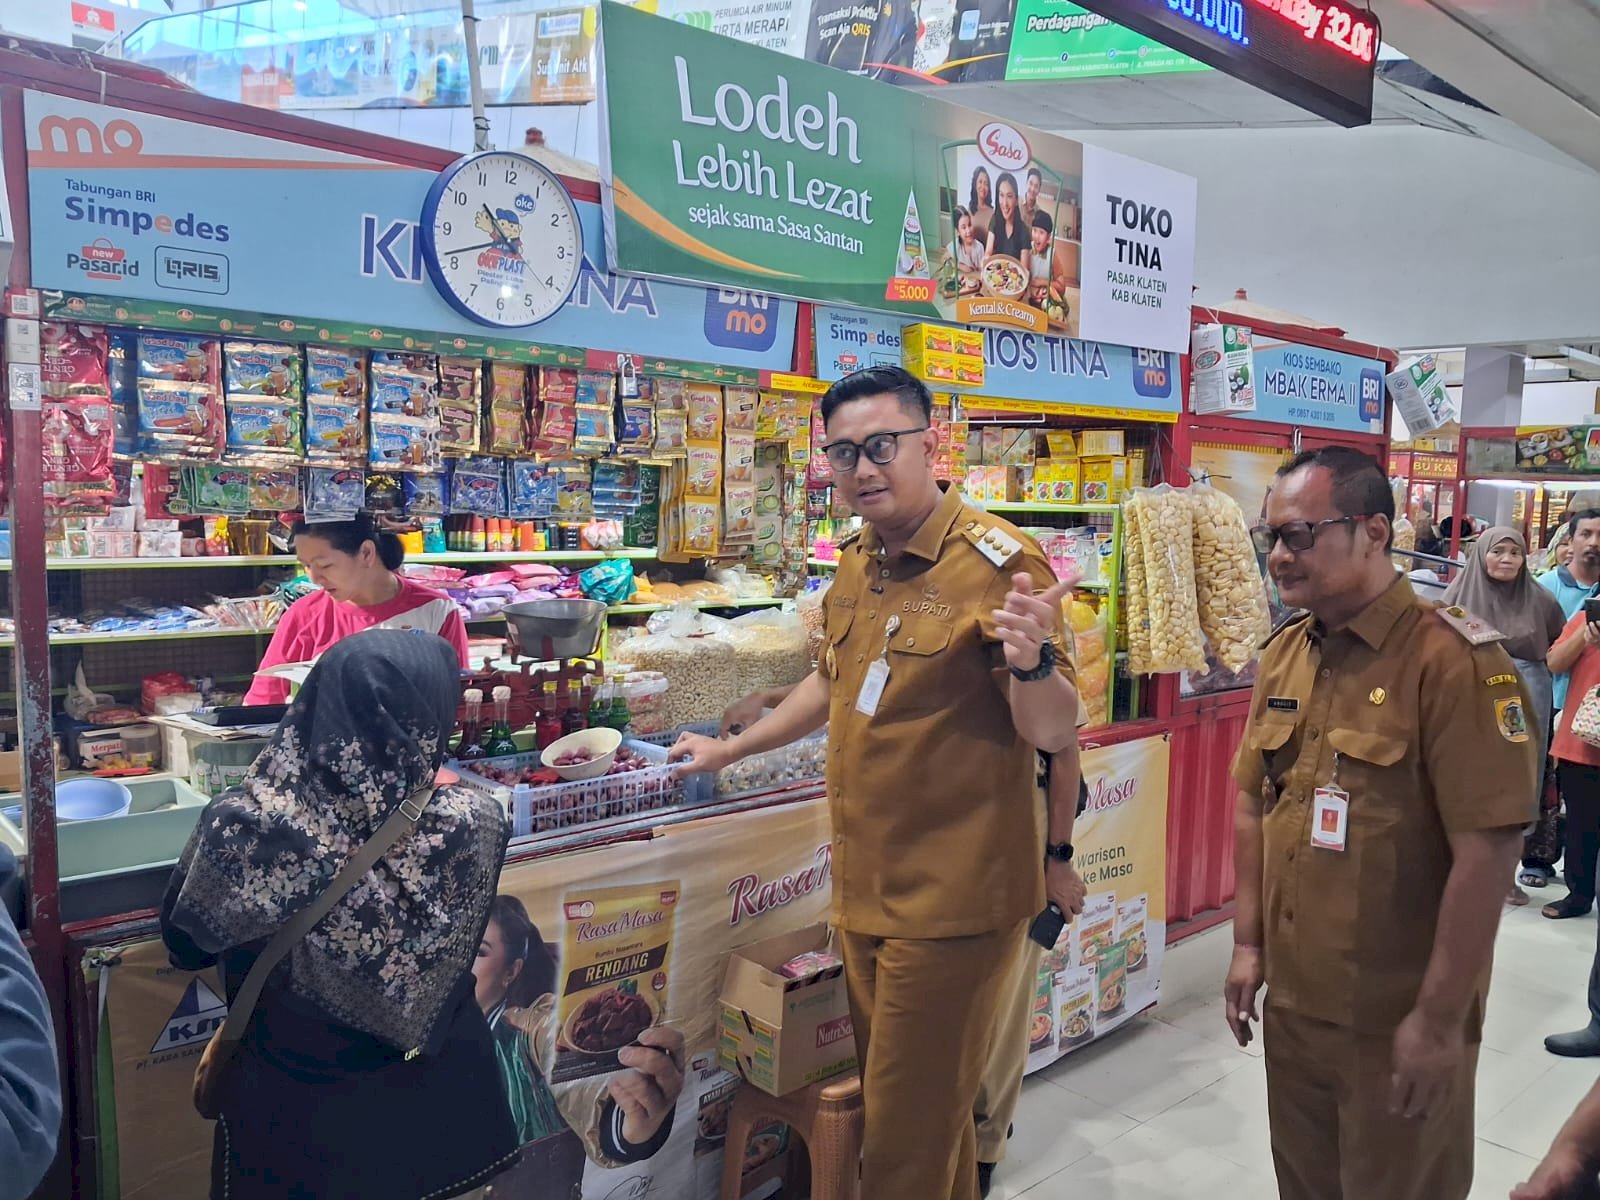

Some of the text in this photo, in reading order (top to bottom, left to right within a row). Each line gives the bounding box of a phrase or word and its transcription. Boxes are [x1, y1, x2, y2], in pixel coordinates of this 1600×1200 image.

[751, 4, 764, 14] AIR
[765, 1, 792, 13] MINUM
[744, 18, 790, 35] MERAPI
[673, 55, 863, 164] Lodeh
[38, 114, 144, 155] mo
[985, 128, 1023, 161] Sasa
[478, 172, 487, 187] 11
[505, 170, 518, 185] 12
[672, 139, 874, 225] Lebih Lezat
[65, 178, 156, 204] Tabungan BRI
[454, 190, 467, 206] 10
[515, 197, 533, 210] oke
[64, 196, 230, 242] Simpedes
[551, 213, 559, 227] 2
[1106, 194, 1173, 239] TOKO
[443, 222, 452, 235] 9
[688, 202, 864, 255] sejak sama Sasa Santan
[92, 247, 114, 260] new
[450, 257, 459, 270] 8
[557, 246, 565, 259] 3
[1115, 238, 1163, 272] TINA
[66, 252, 140, 277] Pasar.id
[470, 284, 478, 296] 7
[545, 276, 554, 288] 4
[899, 284, 929, 300] 5.000
[1107, 270, 1168, 294] PASAR KLATEN
[496, 297, 505, 311] 6
[524, 294, 533, 307] 5
[1111, 287, 1162, 309] KAB KLATEN
[726, 310, 767, 335] mo
[829, 312, 858, 324] Tabungan
[968, 302, 1037, 326] Kental & Creamy
[830, 323, 901, 348] Simpedes
[1044, 335, 1111, 381] TINA
[1283, 351, 1342, 376] KIOS SEMBAKO
[1143, 369, 1166, 386] mo
[1264, 369, 1308, 399] MBAK
[1310, 376, 1347, 405] ERMA
[1362, 377, 1380, 401] BRI
[1413, 461, 1431, 472] BU
[902, 600, 952, 618] BUPATI
[1077, 846, 1126, 869] Warisan
[1083, 863, 1134, 885] ke Masa
[728, 864, 816, 926] Rasa
[576, 909, 664, 944] Rasa Masa
[585, 952, 649, 984] RENDANG
